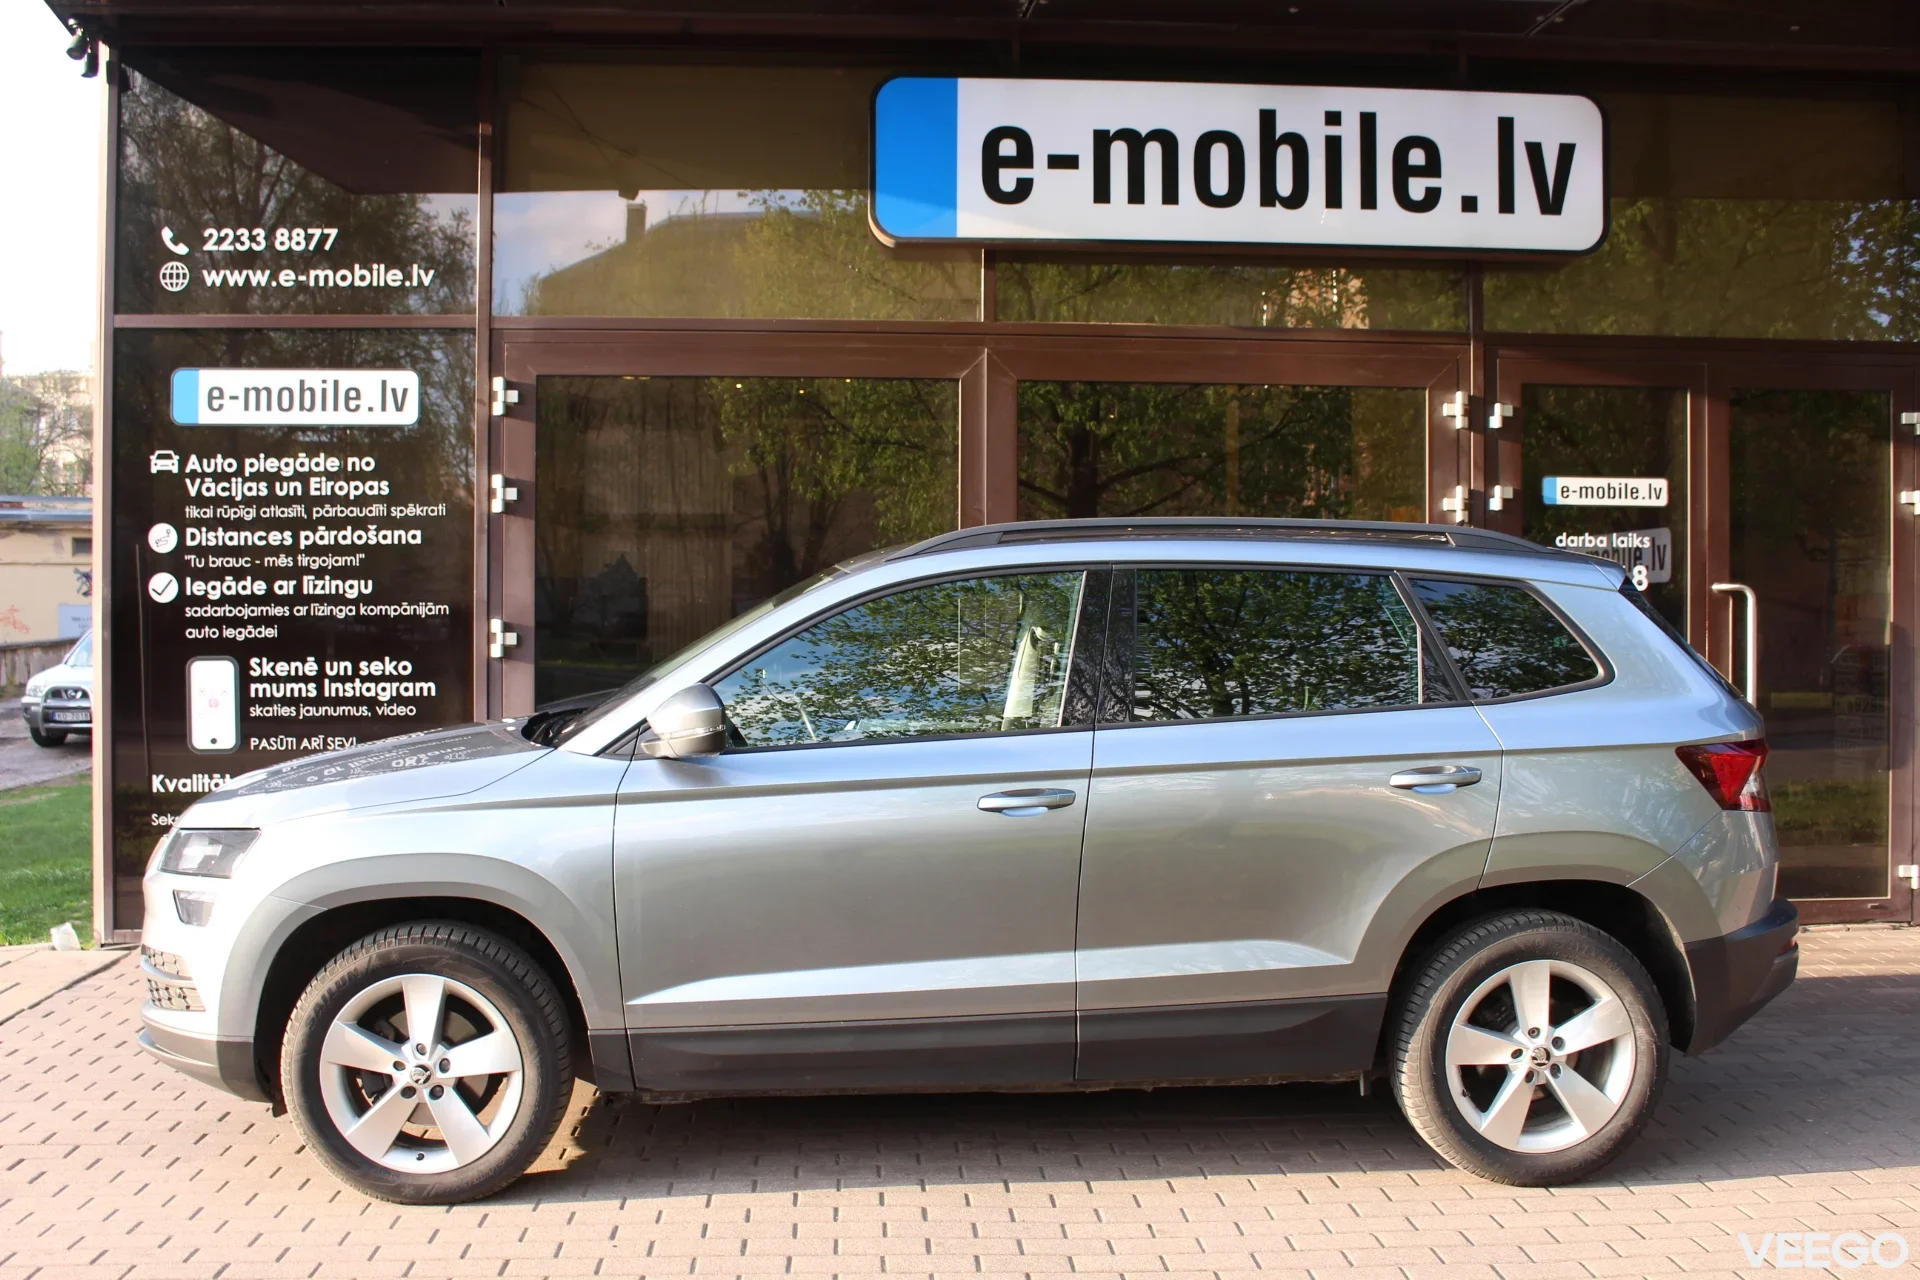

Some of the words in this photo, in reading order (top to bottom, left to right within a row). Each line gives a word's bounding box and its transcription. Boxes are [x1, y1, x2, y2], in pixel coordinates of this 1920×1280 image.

[980, 109, 1576, 216] e-mobile.lv
[202, 228, 266, 251] 2233
[274, 227, 338, 251] 8877
[202, 264, 435, 287] www.e-mobile.lv
[207, 379, 409, 412] e-mobile.lv
[185, 454, 238, 473] Auto
[244, 452, 340, 477] piegāde
[347, 456, 375, 471] no
[185, 478, 268, 501] Vācijas
[275, 480, 301, 496] un
[309, 477, 389, 500] Eiropas
[1560, 482, 1662, 500] e-mobile.lv
[185, 505, 214, 519] tikai
[216, 504, 256, 521] rūpīgi
[260, 504, 308, 520] atlasīti,
[312, 503, 387, 520] pārbaudīti
[390, 503, 447, 520] spēkrati
[185, 526, 293, 547] Distances
[300, 525, 422, 549] pārdošana
[1555, 532, 1607, 548] darba
[1612, 532, 1651, 548] laiks
[184, 555, 205, 568] "Tu
[209, 554, 251, 567] brauc
[264, 553, 294, 568] mēs
[297, 553, 365, 570] tirgojam!"
[186, 576, 267, 600] Iegāde
[273, 580, 296, 596] ar
[302, 575, 373, 599] līzingu
[185, 604, 290, 621] sadarbojamies
[293, 606, 309, 617] ar
[311, 603, 356, 619] līzinga
[360, 603, 449, 619] kompānijām
[185, 626, 219, 639] auto
[222, 624, 278, 641] iegādei
[249, 656, 318, 677] Skenē
[325, 660, 352, 676] un
[358, 657, 412, 677] seko
[250, 681, 317, 698] mums
[324, 678, 436, 702] Instagram
[250, 704, 297, 717] skaties
[299, 704, 372, 719] jaunumus,
[375, 703, 417, 717] video
[250, 735, 297, 751] PASŪTI
[300, 735, 325, 751] ARĪ
